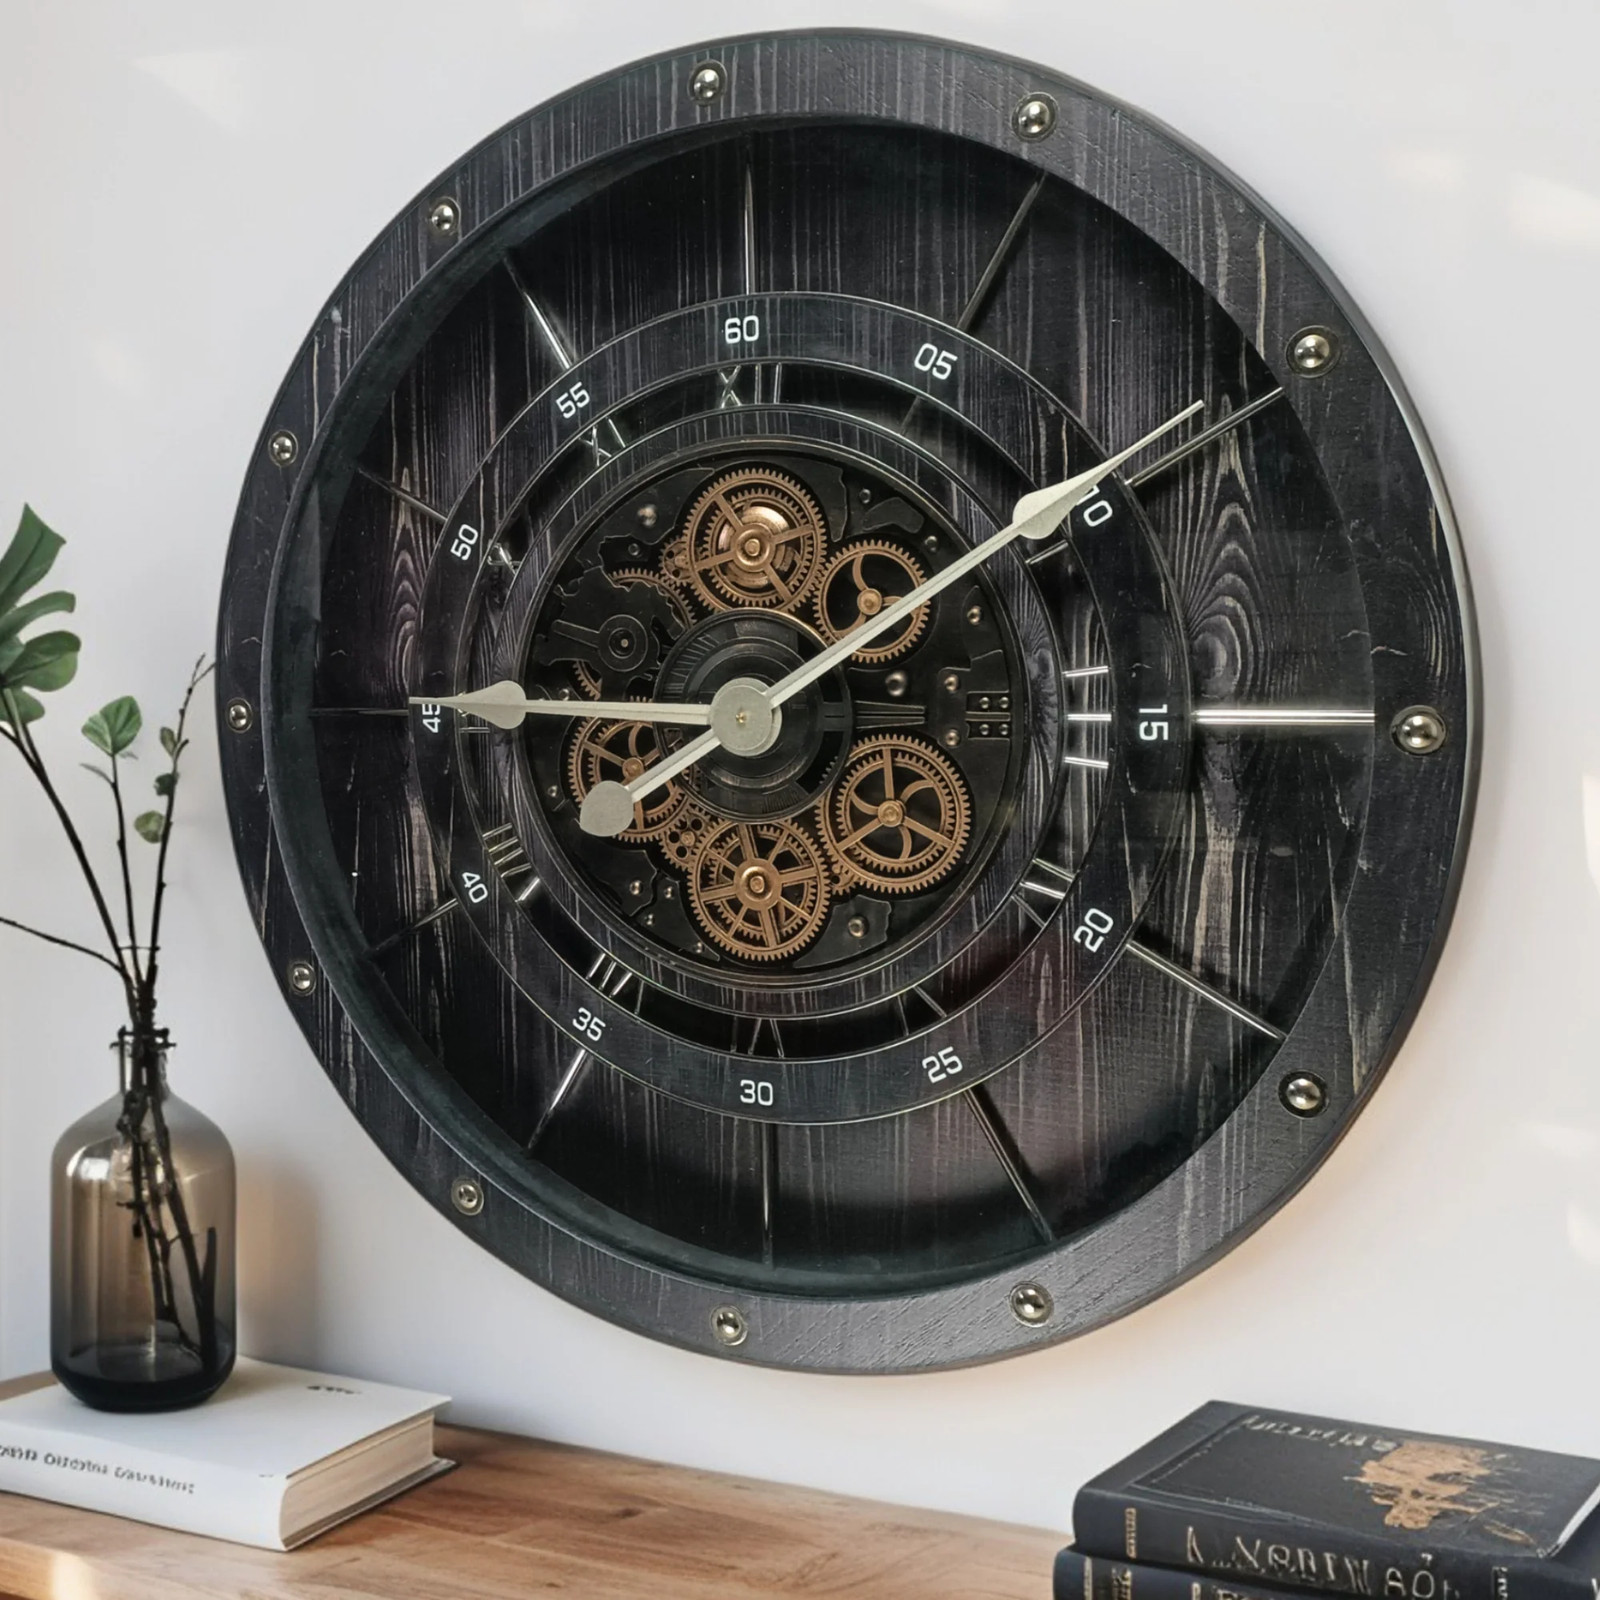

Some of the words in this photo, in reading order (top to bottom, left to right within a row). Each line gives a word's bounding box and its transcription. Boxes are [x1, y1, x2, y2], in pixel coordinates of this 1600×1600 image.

[724, 314, 760, 345] 60
[913, 342, 959, 381] 05
[555, 381, 591, 419] 55
[717, 361, 783, 409] XII
[579, 416, 626, 467] XI
[1076, 484, 1114, 528] 10
[450, 523, 479, 561] 50
[421, 703, 442, 734] 45
[1138, 703, 1170, 741] 15
[461, 871, 489, 904] 40
[1073, 907, 1115, 953] 20
[572, 1007, 607, 1042] 35
[921, 1046, 963, 1084] 25
[739, 1079, 774, 1107] 30
